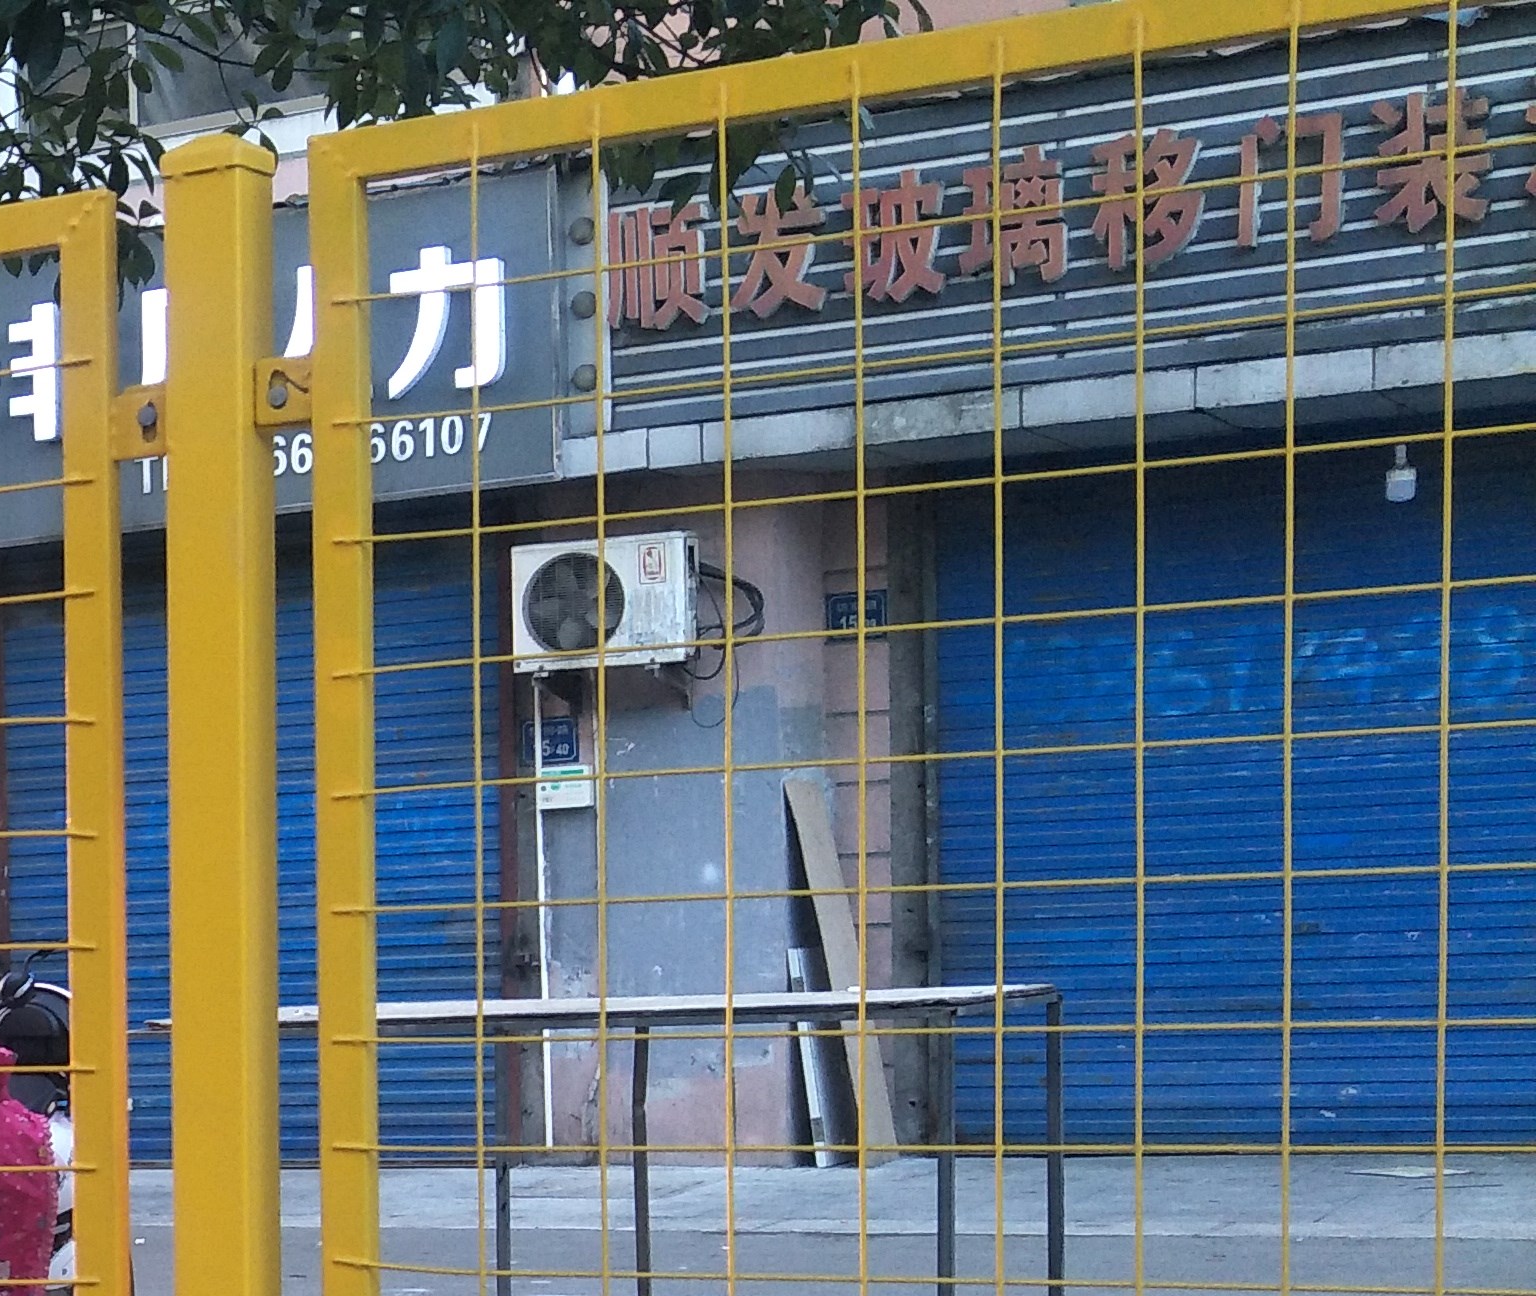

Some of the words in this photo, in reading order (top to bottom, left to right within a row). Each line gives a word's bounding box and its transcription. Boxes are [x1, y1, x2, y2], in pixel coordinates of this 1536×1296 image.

[608, 87, 1536, 330] 顺发玻璃移门装
